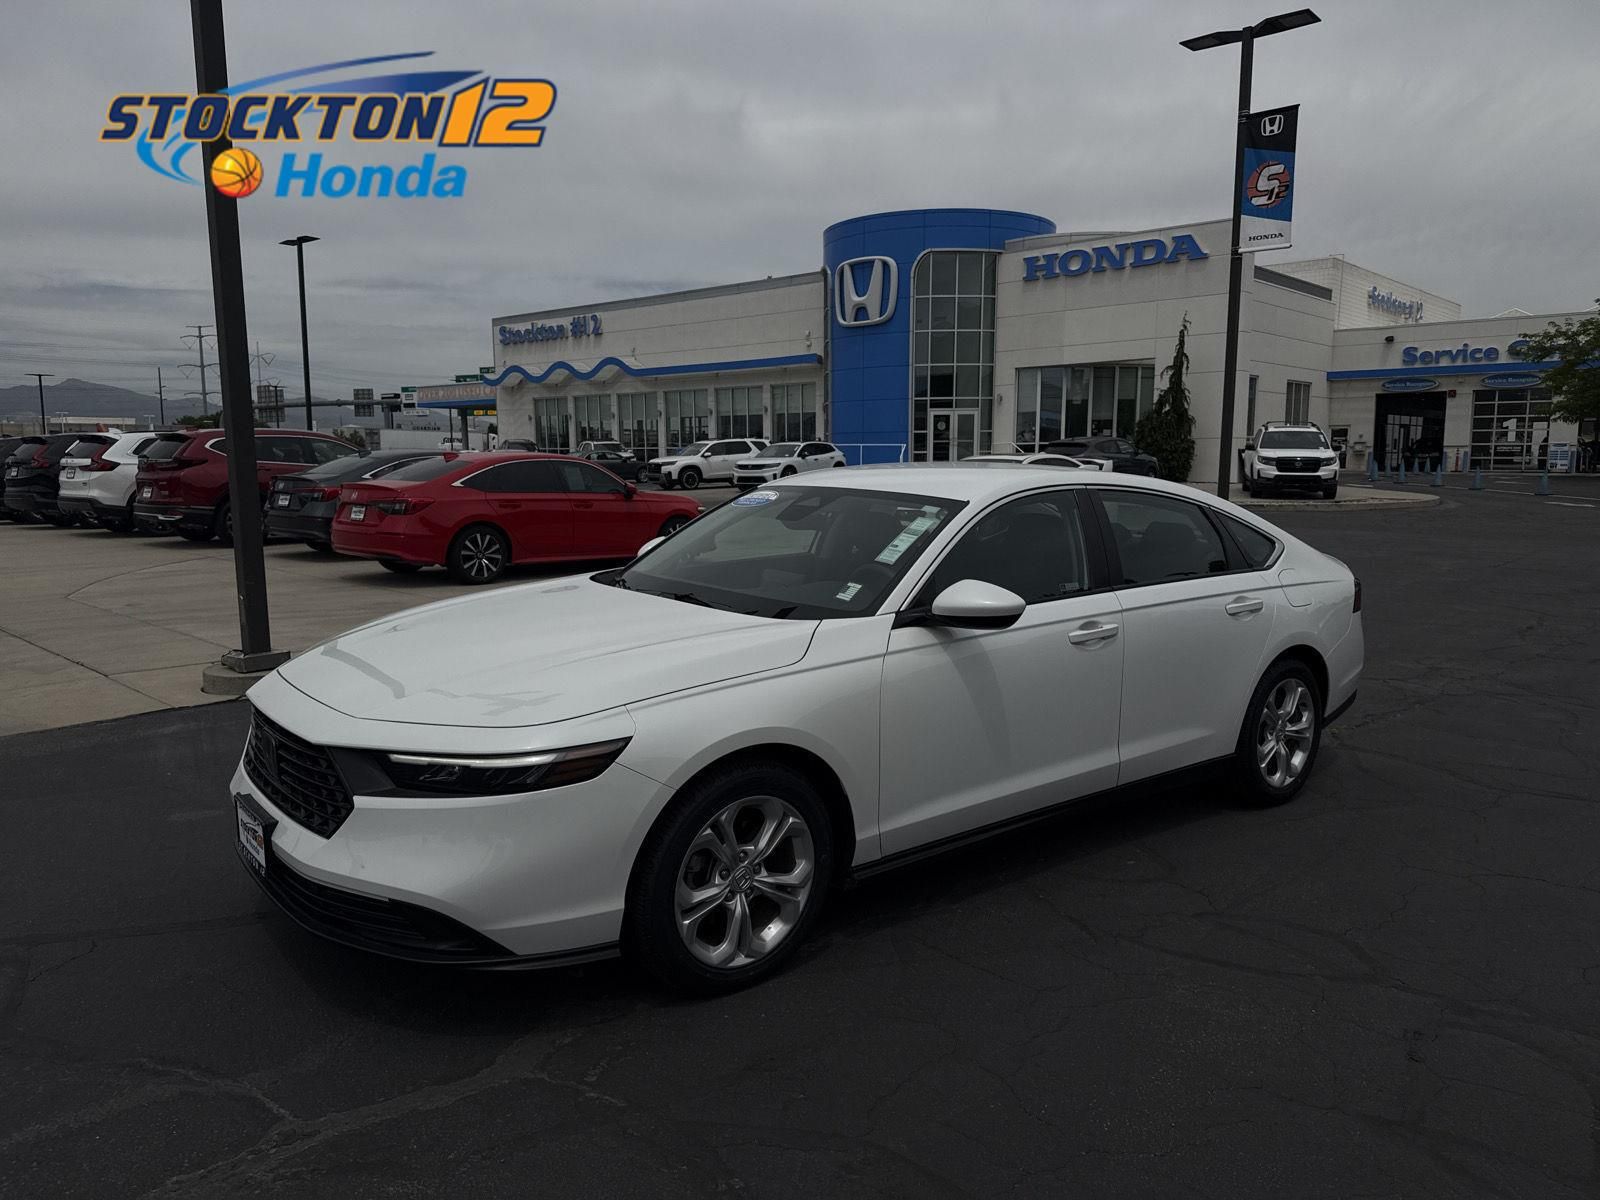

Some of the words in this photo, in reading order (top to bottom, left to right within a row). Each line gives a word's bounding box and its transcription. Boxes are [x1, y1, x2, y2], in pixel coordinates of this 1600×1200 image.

[1248, 232, 1285, 242] HONDA
[1023, 234, 1209, 281] HONDA
[498, 322, 568, 345] Stockton
[570, 313, 603, 338] #12
[1402, 343, 1499, 365] Service
